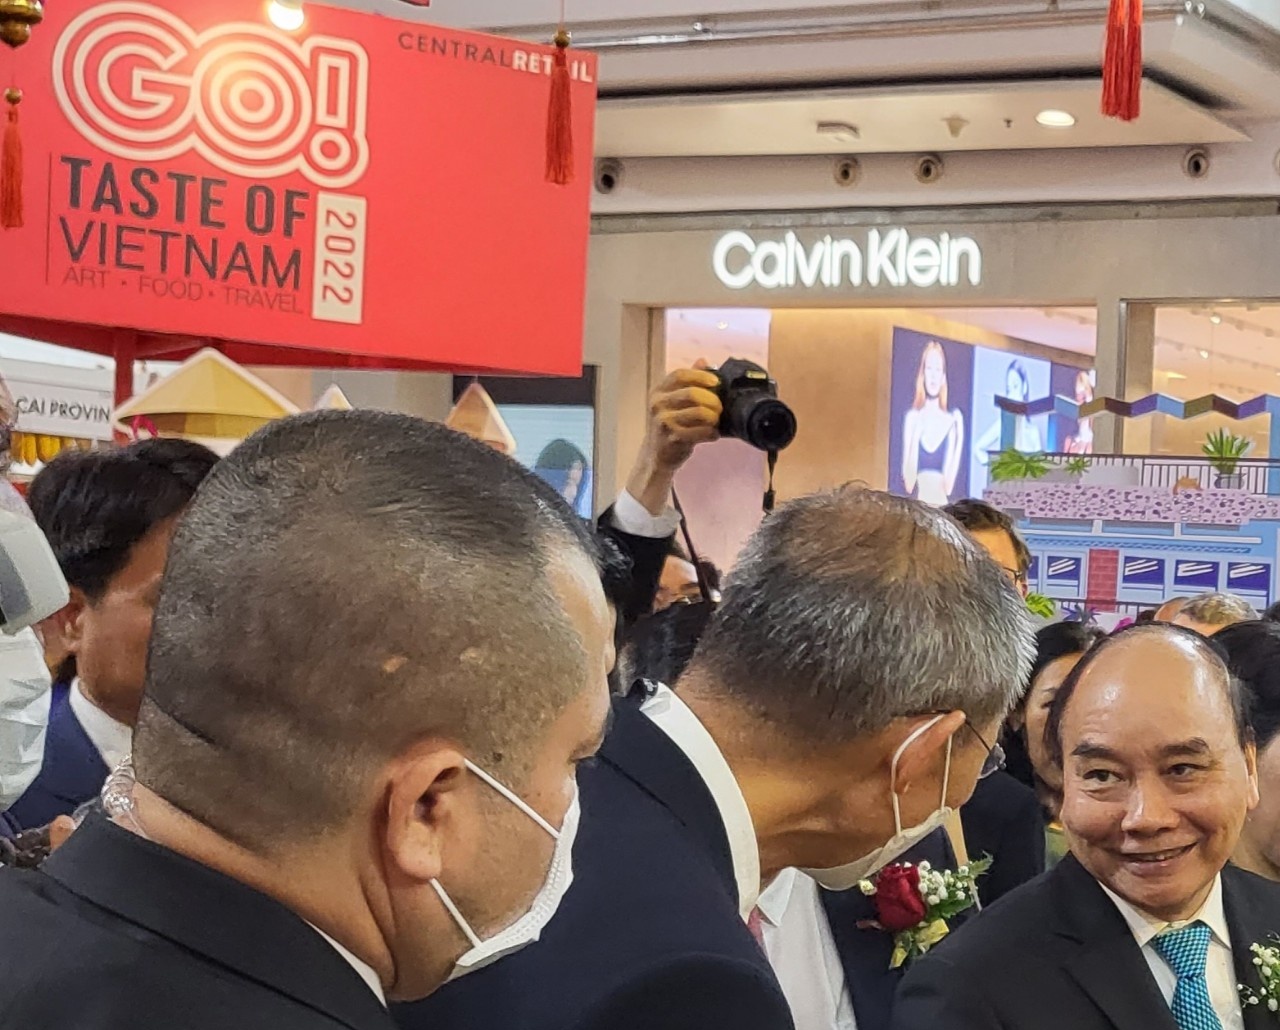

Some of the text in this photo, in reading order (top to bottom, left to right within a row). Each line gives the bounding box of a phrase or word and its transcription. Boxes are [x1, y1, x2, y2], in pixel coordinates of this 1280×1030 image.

[52, 1, 370, 189] GO!
[397, 32, 594, 83] CENTRALRETIL
[60, 155, 311, 239] TASTE OF
[59, 215, 303, 292] VIETNAM
[61, 265, 305, 315] ART FOOD TRAVEL
[321, 207, 358, 306] 2022
[712, 227, 983, 289] Calvin Klein
